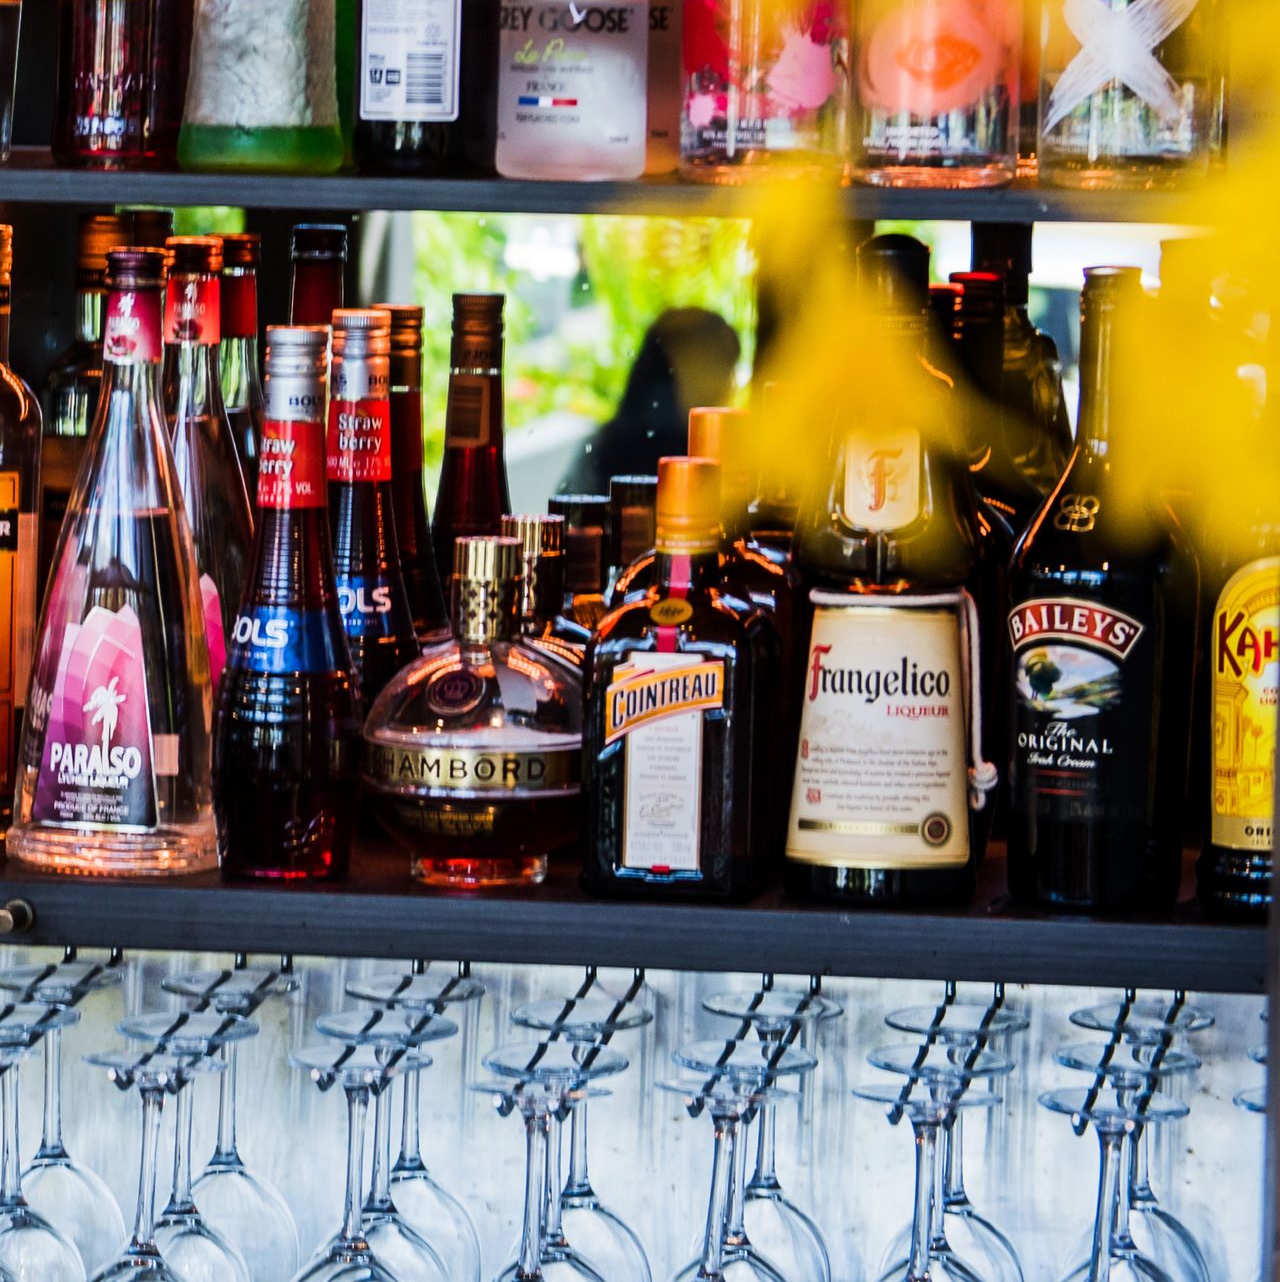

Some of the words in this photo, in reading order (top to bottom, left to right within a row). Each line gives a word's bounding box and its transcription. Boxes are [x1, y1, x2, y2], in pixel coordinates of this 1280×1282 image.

[539, 6, 629, 32] GOOSE
[338, 413, 384, 431] Straw
[261, 437, 295, 455] traw
[340, 434, 382, 454] berry
[338, 586, 391, 615] OLS
[1011, 605, 1132, 646] BAILEYS
[808, 643, 951, 703] Frangelico
[611, 672, 717, 730] COINTREAU
[887, 705, 949, 720] LIQUEUR
[1045, 721, 1077, 737] The
[1018, 732, 1113, 754] ORIGINAL
[377, 753, 547, 782] HAMBORD
[1027, 752, 1054, 767] Irish
[1057, 754, 1096, 768] Cream
